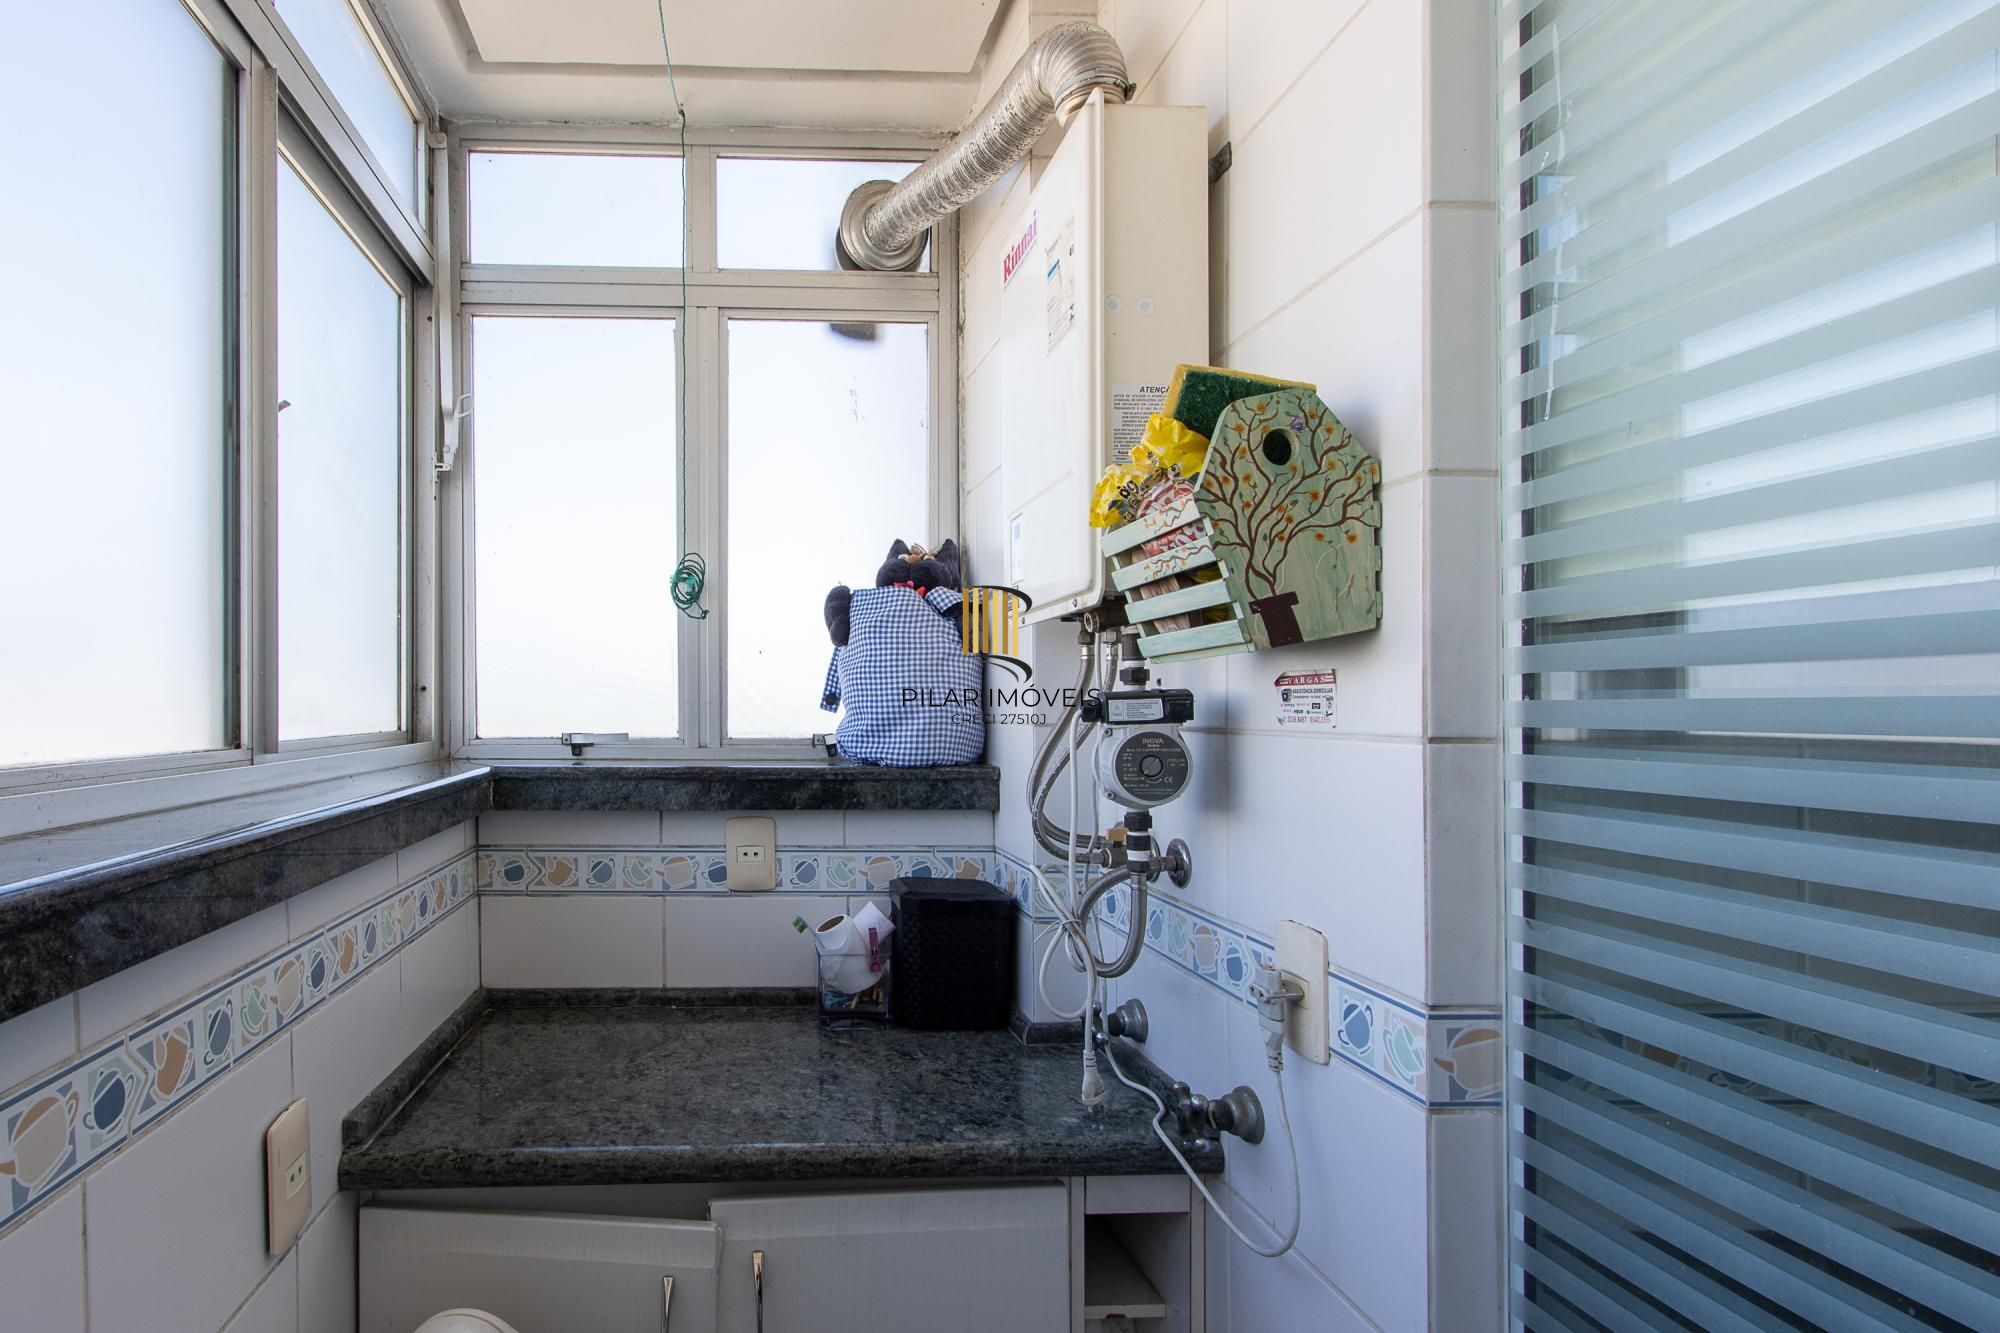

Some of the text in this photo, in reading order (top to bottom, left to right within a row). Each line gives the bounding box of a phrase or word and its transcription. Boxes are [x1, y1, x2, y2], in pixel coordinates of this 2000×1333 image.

[1003, 208, 1037, 284] Rinnai
[1139, 386, 1170, 394] ATENÇ
[1288, 676, 1326, 684] VARGAS
